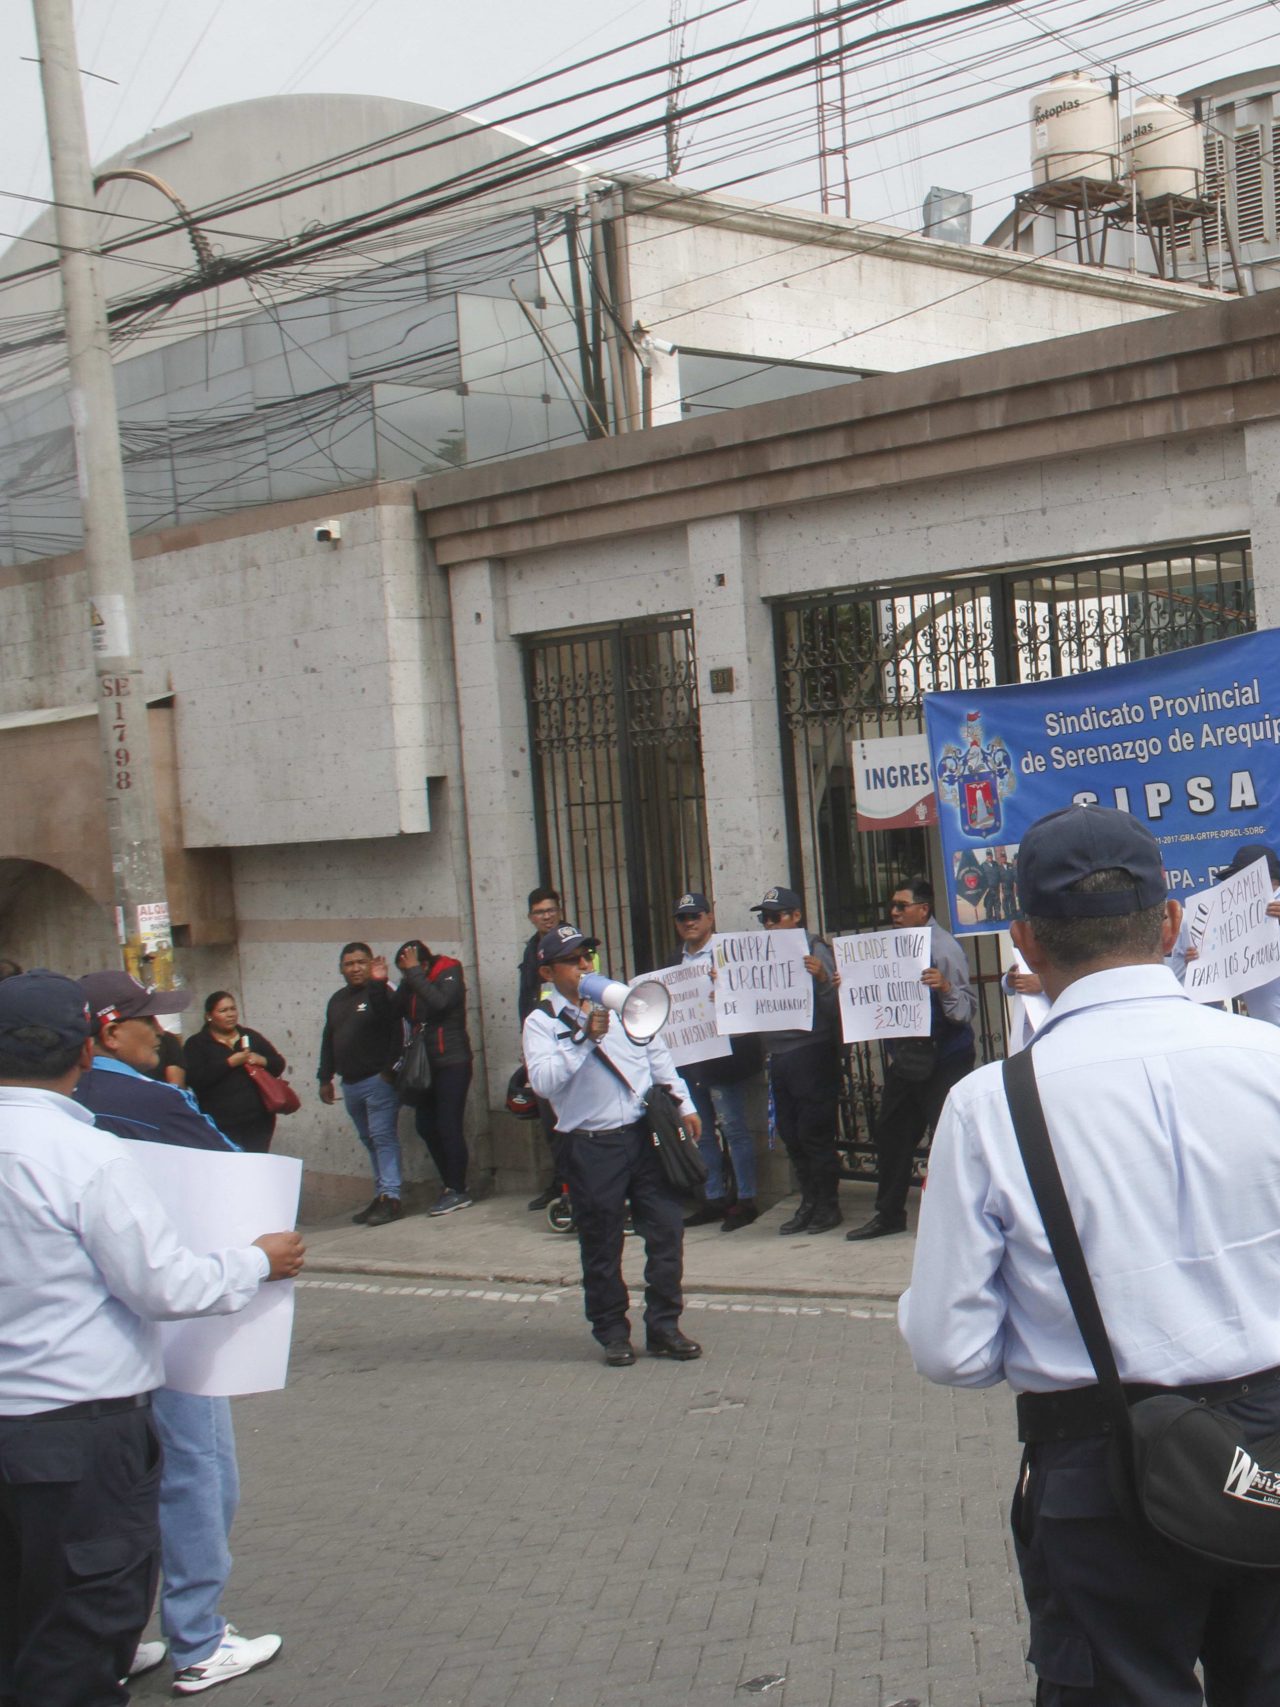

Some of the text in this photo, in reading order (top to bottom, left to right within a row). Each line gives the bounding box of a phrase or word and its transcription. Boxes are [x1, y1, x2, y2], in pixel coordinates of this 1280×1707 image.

[101, 677, 131, 697] SE
[1045, 677, 1261, 738] Sindicato Provincial
[1020, 749, 1047, 775] de
[1051, 735, 1162, 773] Serenazgo
[1168, 726, 1195, 753] de
[865, 762, 930, 790] INGRES
[1166, 868, 1195, 890] IPA
[1220, 868, 1264, 913] EXAMEN
[1189, 902, 1210, 947] ALTO
[844, 933, 925, 964] ALCALDE CUMPLA
[728, 960, 796, 992] URGENTE
[873, 962, 902, 979] CON EL
[1191, 961, 1219, 987] PARA
[1224, 951, 1239, 978] LOS
[724, 1000, 738, 1016] DE
[849, 984, 882, 1006] PACTO
[884, 1003, 917, 1030] 2024
